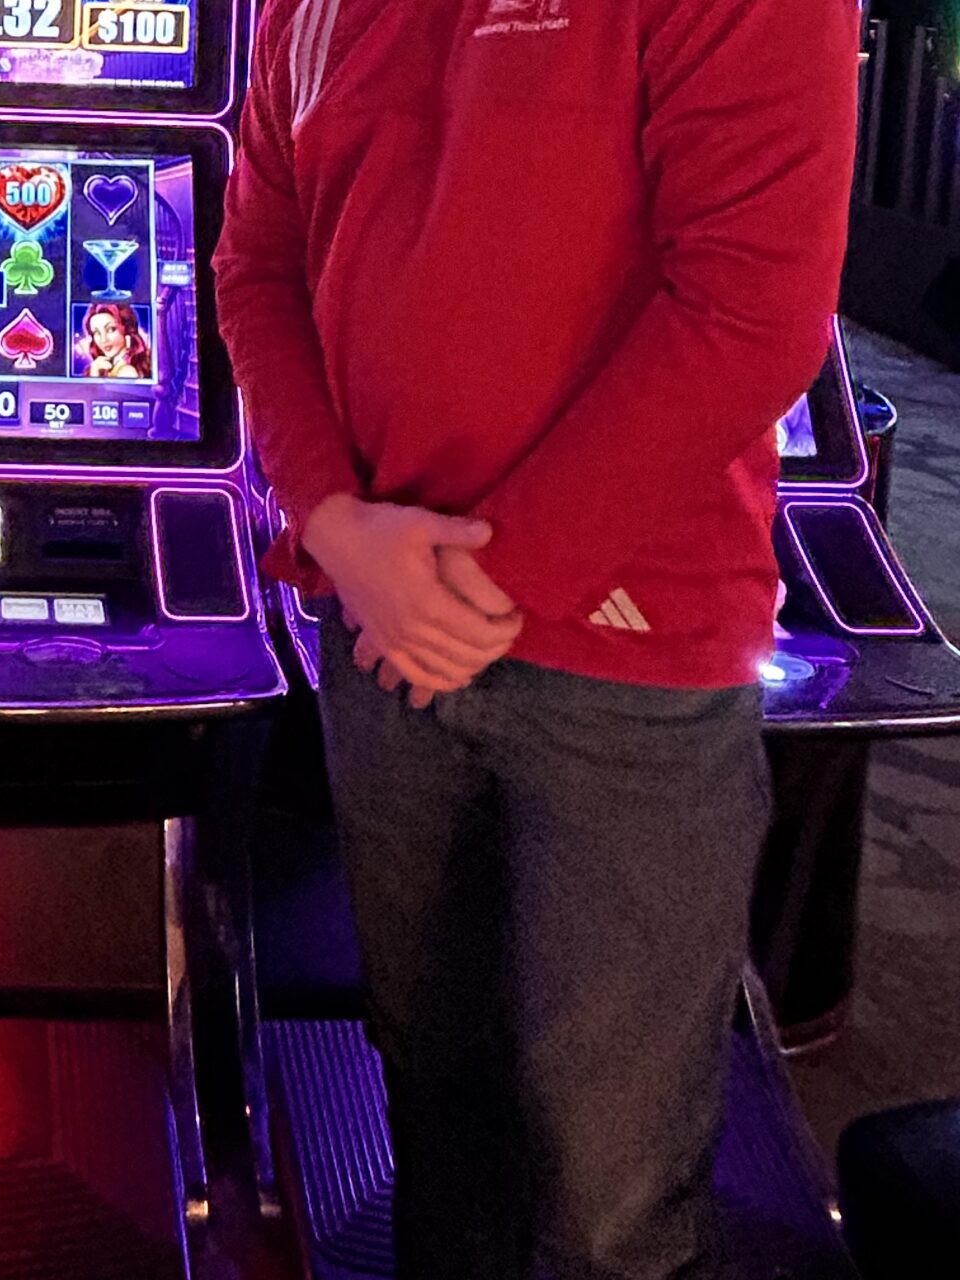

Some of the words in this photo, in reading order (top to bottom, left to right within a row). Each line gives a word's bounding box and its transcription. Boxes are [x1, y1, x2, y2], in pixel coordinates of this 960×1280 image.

[97, 9, 175, 44] $100
[5, 181, 53, 207] 500
[43, 403, 70, 420] 50
